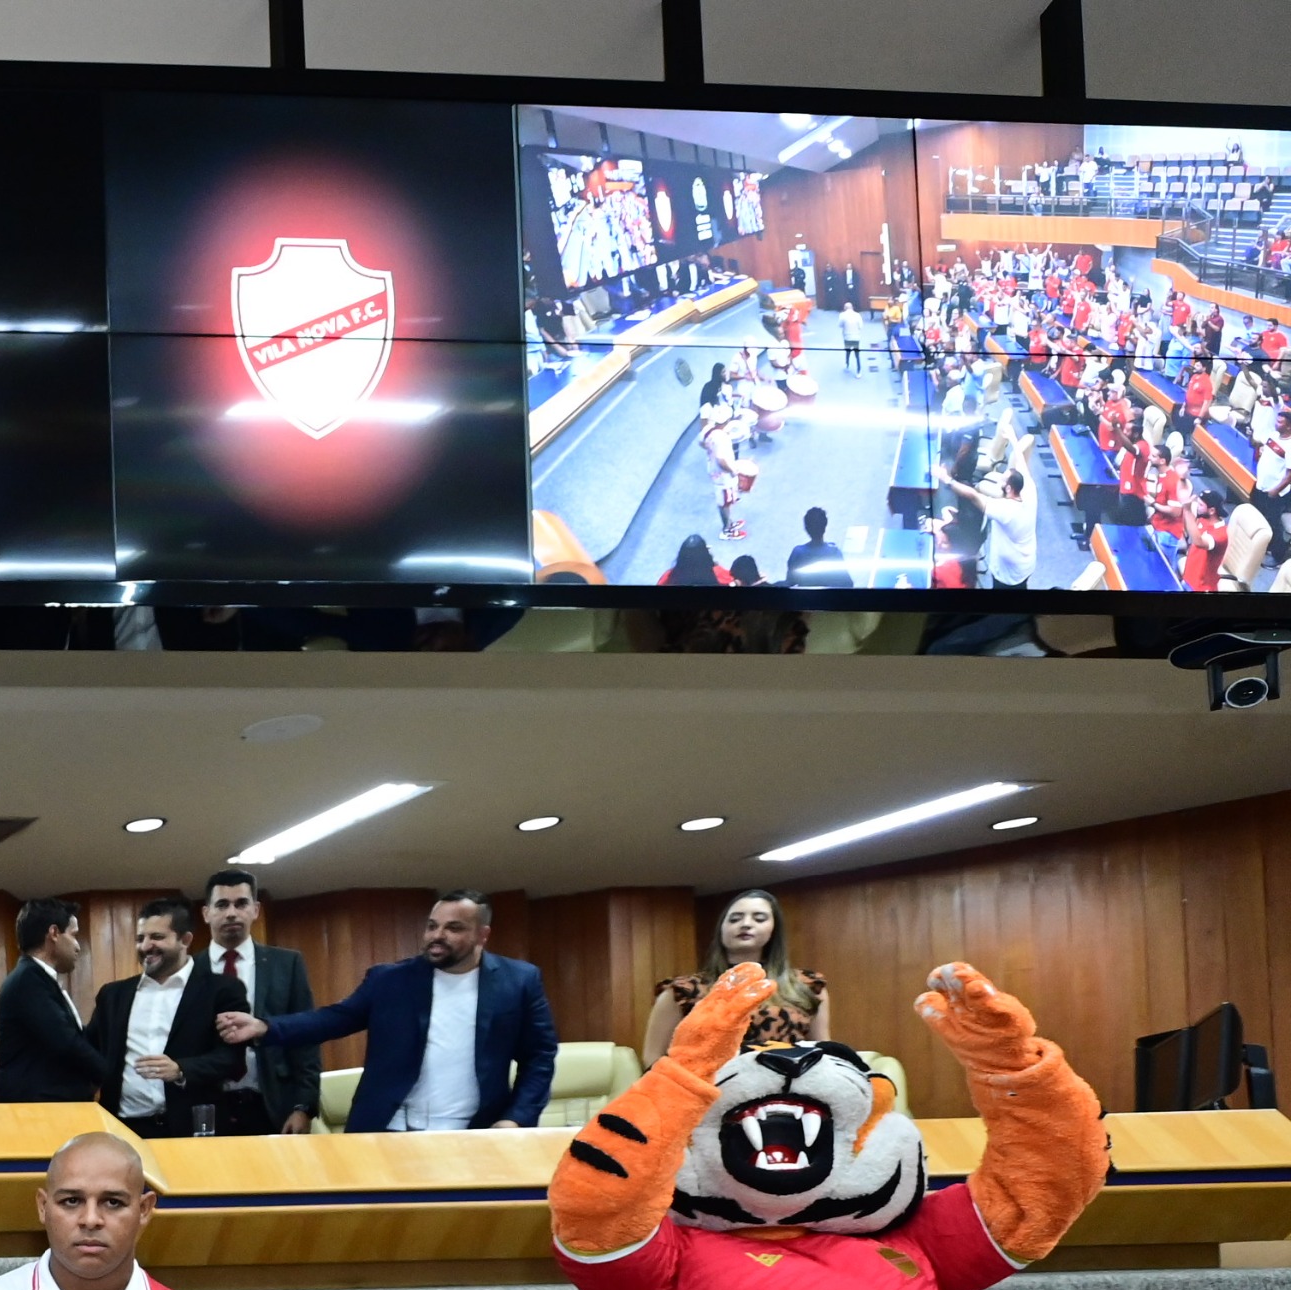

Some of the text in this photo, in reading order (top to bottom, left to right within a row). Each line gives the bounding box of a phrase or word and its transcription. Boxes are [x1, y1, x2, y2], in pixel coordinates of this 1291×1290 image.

[253, 302, 383, 365] VILA NOVA F.C.
